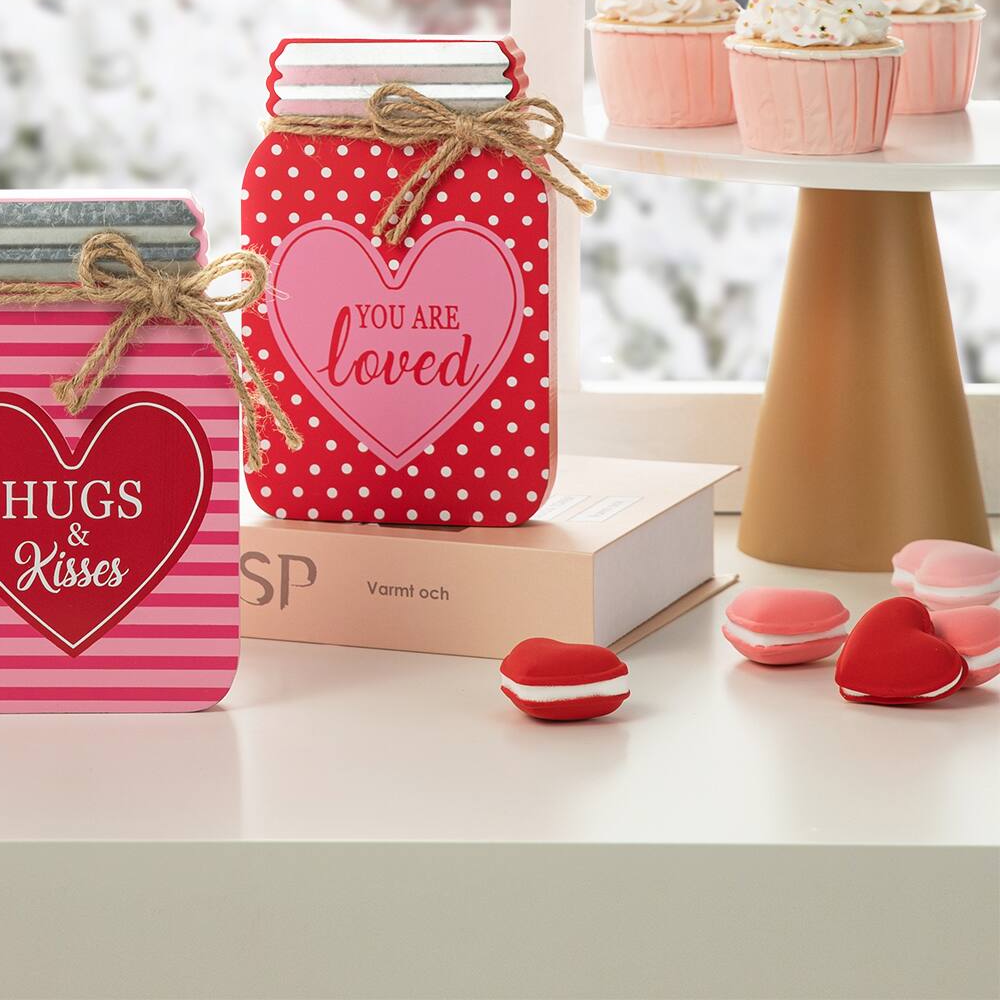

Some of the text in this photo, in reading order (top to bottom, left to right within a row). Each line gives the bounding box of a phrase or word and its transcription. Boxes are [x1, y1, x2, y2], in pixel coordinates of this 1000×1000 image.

[354, 303, 460, 330] YOU ARE
[317, 306, 480, 388] loved
[2, 479, 143, 520] HUGS
[67, 522, 90, 547] &
[14, 540, 130, 594] Kisses
[366, 581, 450, 601] Varmt och
